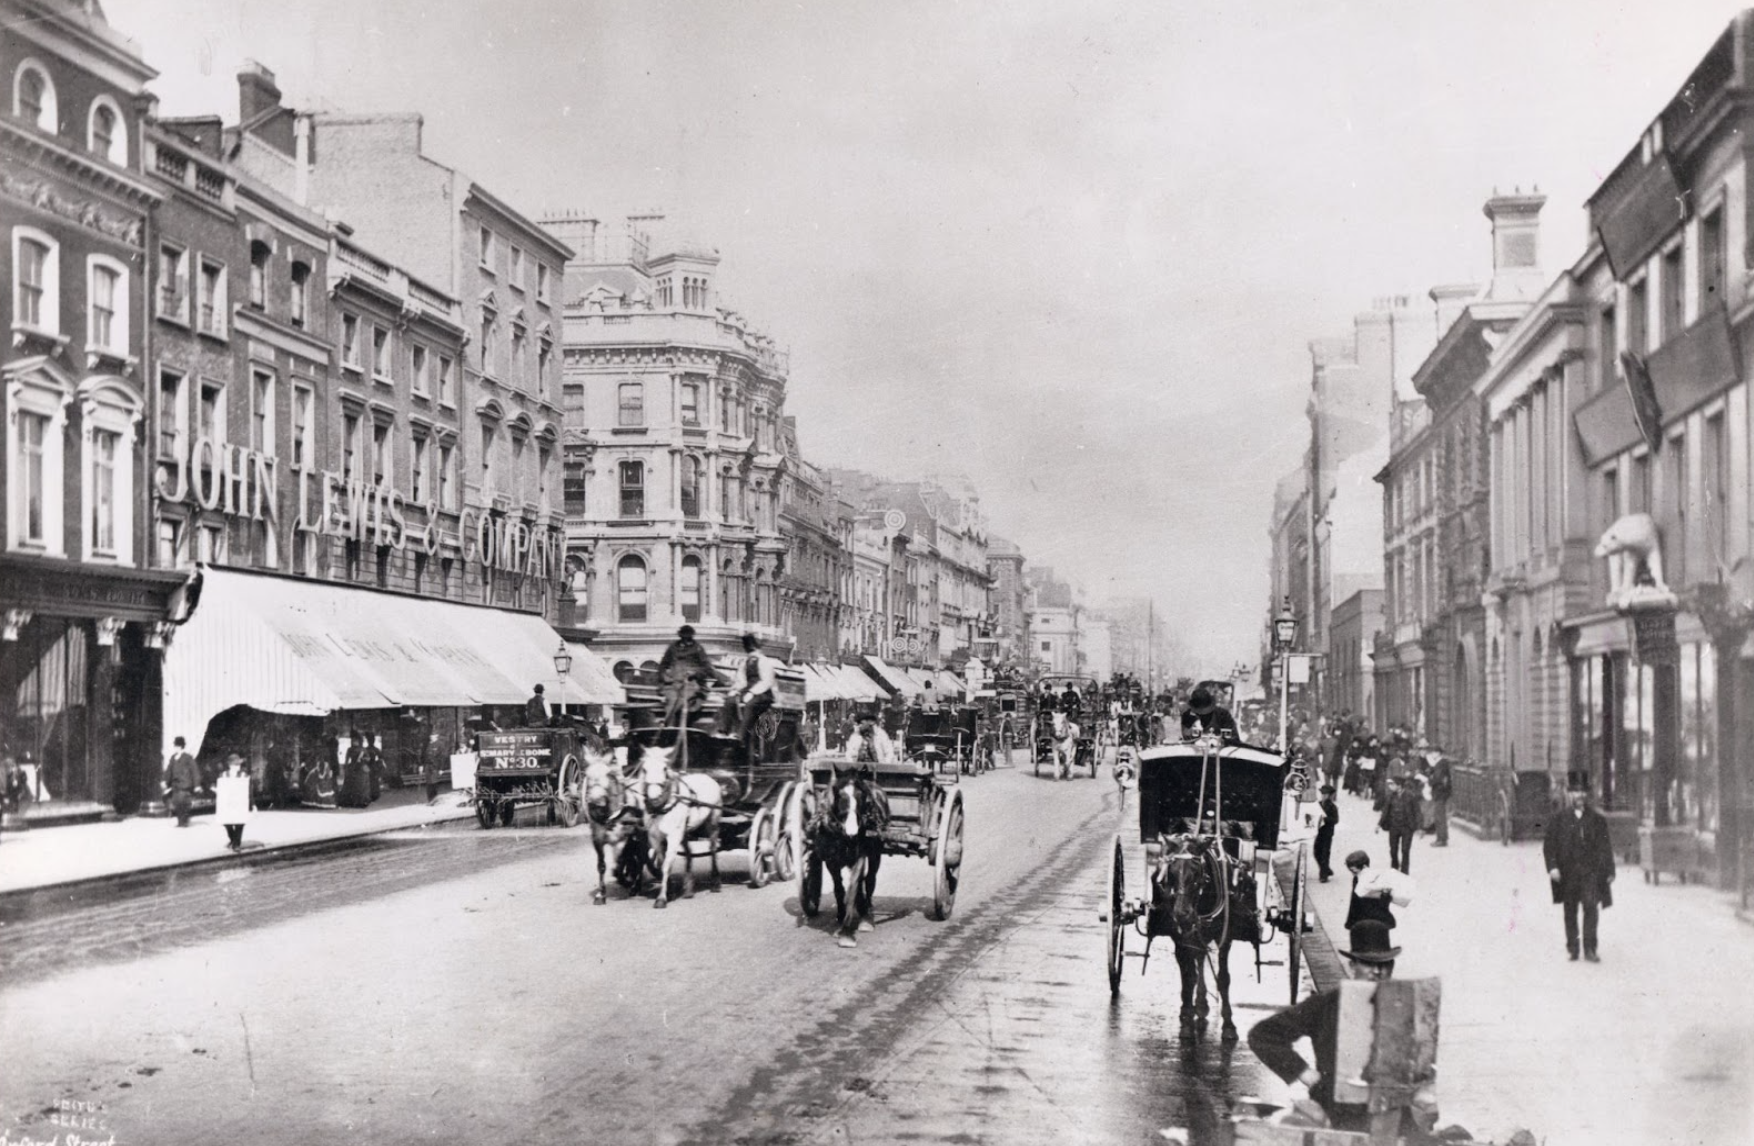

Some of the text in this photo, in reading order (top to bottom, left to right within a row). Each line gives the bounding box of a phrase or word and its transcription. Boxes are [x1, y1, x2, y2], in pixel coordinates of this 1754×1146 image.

[155, 430, 568, 583] JOHN LEWIS & COMPANY
[494, 735, 538, 744] VESTRY
[489, 748, 552, 757] MARYEBONE
